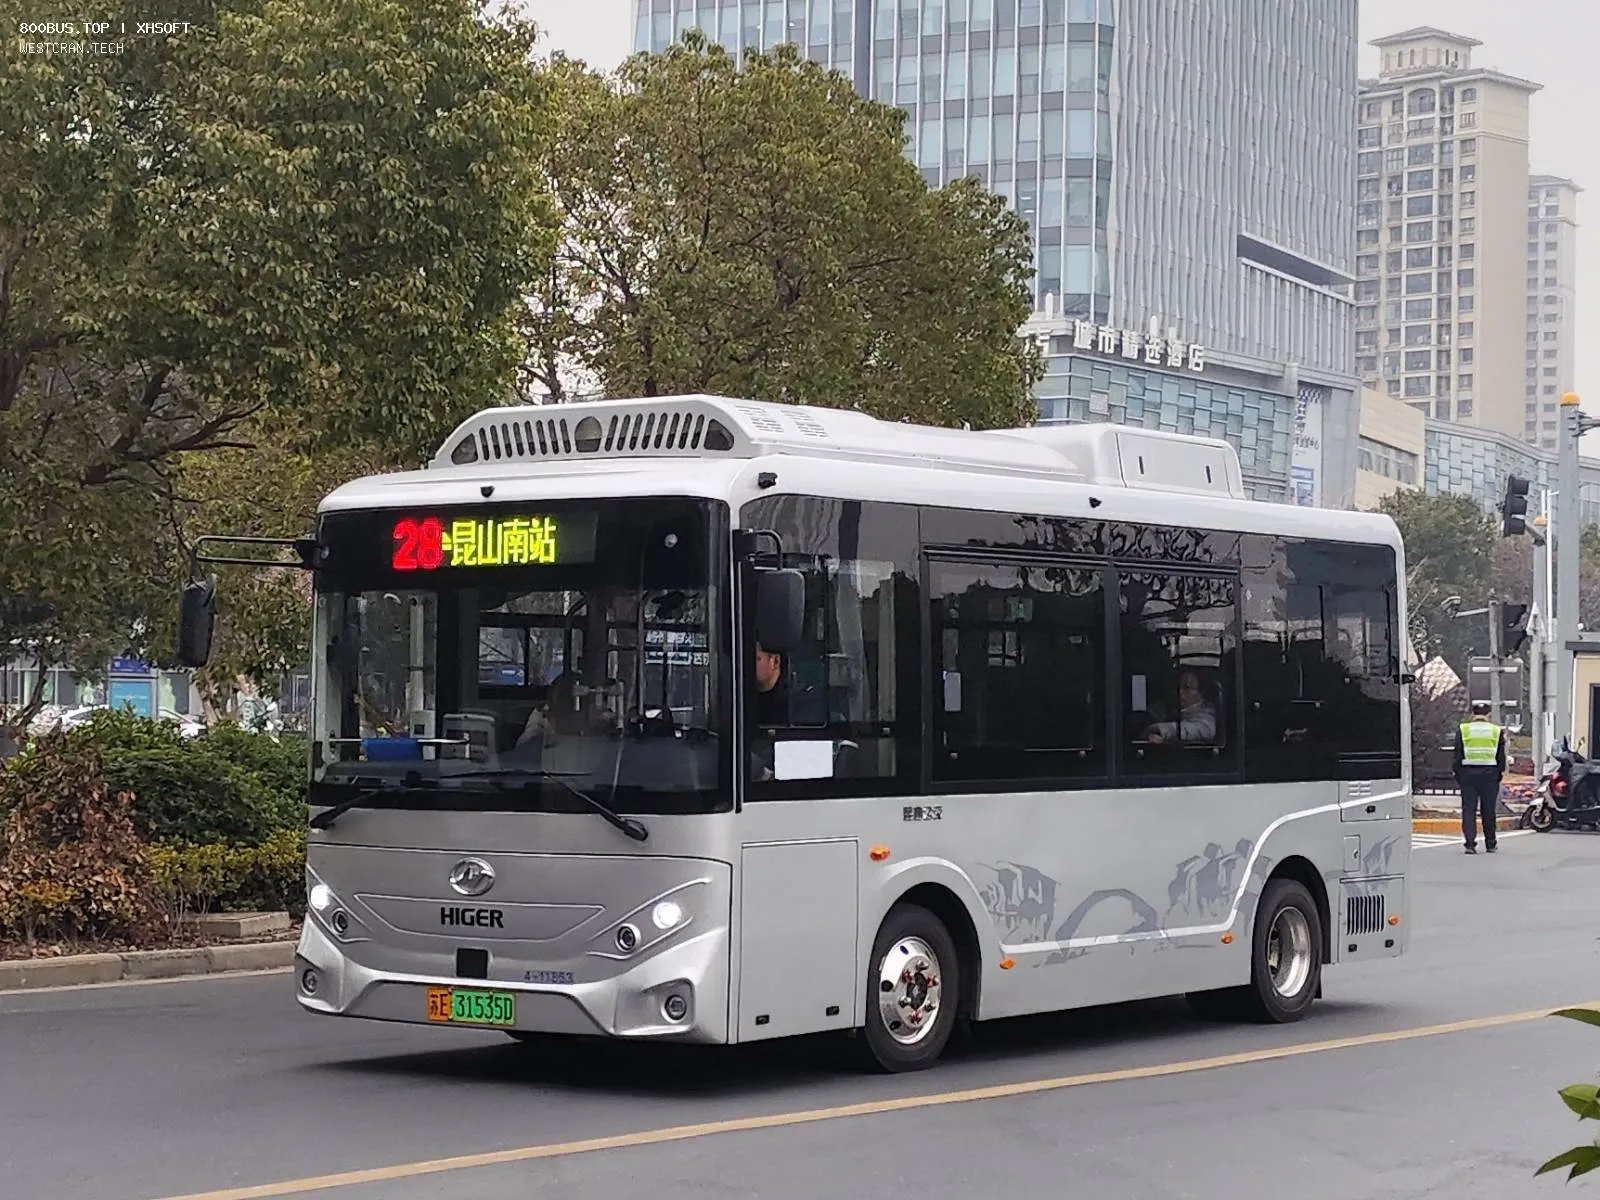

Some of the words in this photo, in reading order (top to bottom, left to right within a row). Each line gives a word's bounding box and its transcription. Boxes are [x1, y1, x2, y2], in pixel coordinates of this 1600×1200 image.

[450, 517, 557, 566] 昆山南站
[440, 906, 504, 928] HIGER
[455, 994, 513, 1020] 31535D
